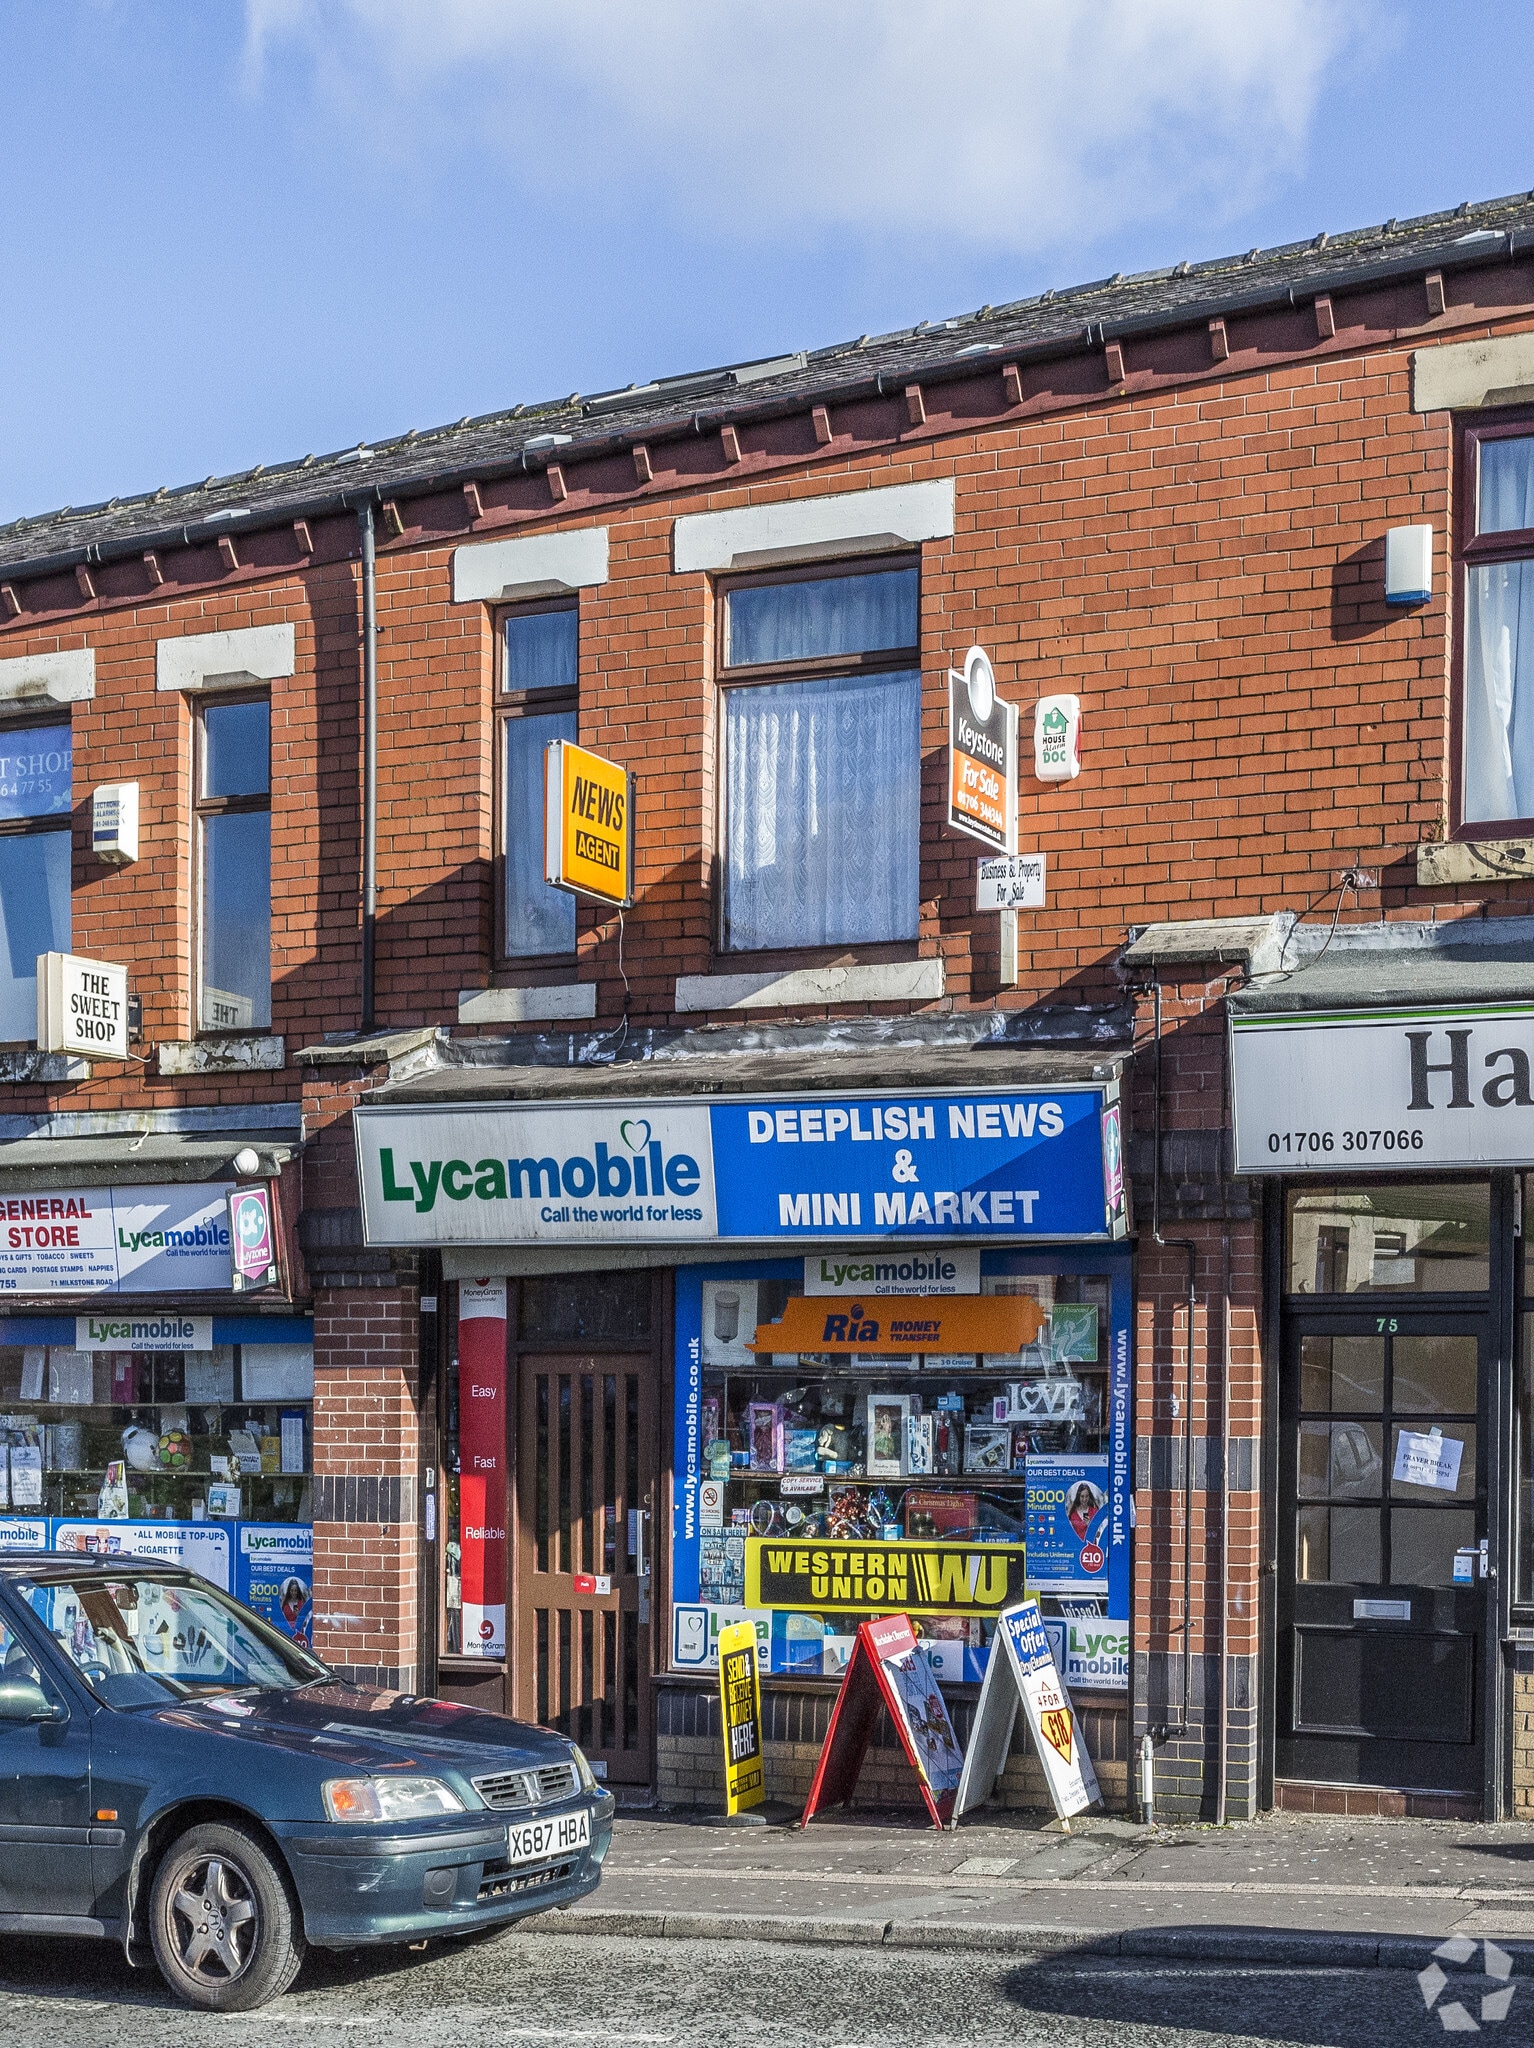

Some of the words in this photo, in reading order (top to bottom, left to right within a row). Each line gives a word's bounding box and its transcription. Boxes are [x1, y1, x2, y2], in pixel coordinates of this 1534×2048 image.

[958, 717, 1004, 765] Keystone
[1043, 735, 1066, 744] HOUSE
[16, 751, 72, 777] SHOP
[1043, 750, 1066, 764] DOC
[963, 760, 979, 788] For
[979, 768, 999, 801] Sale
[571, 776, 625, 831] NEWS
[577, 833, 620, 868] AGENT
[981, 860, 1007, 880] Business
[1008, 864, 1016, 878] &
[1018, 860, 1041, 883] Property
[997, 883, 1007, 902] For
[1011, 881, 1024, 901] Sale
[81, 972, 110, 997] THE
[71, 994, 120, 1021] SWEET
[76, 1017, 116, 1042] SHOP
[1404, 1028, 1534, 1111] Ha
[748, 1105, 935, 1143] DEEPLISH
[949, 1102, 1064, 1138] NEWS
[1268, 1131, 1335, 1153] 01706
[1342, 1129, 1424, 1151] 307066
[379, 1140, 701, 1213] Lycamobile
[892, 1149, 920, 1183] &
[541, 1206, 570, 1222] Call
[573, 1206, 598, 1222] the
[600, 1205, 643, 1221] world
[646, 1205, 669, 1221] for
[671, 1204, 703, 1221] less
[779, 1192, 861, 1226] MINI
[874, 1190, 1039, 1225] MARKET
[8, 1225, 80, 1248] STORE
[118, 1224, 229, 1252] Lycamobile
[166, 1249, 178, 1257] Call
[178, 1249, 189, 1257] the
[190, 1249, 208, 1257] world
[209, 1248, 218, 1256] for
[89, 1264, 114, 1272] NAPPIES
[821, 1256, 956, 1286] Lycamobile
[463, 1288, 503, 1297] MoneyGram
[875, 1286, 890, 1294] Call
[891, 1285, 904, 1293] the
[904, 1285, 927, 1293] world
[928, 1285, 939, 1293] for
[940, 1285, 956, 1293] less
[89, 1318, 194, 1342] Lycamobile
[822, 1304, 880, 1342] Ria
[890, 1321, 942, 1332] MONEY
[1376, 1318, 1398, 1332] 75
[889, 1334, 940, 1342] TRANSFER
[471, 1385, 497, 1400] Easy
[684, 1337, 700, 1540] www.lycamobile.co.uk
[1112, 1328, 1129, 1546] www.lycamobile.co.uk
[474, 1456, 496, 1469] Fast
[1062, 1469, 1085, 1477] DEALS
[1403, 1454, 1429, 1465] PRAYER
[1430, 1460, 1453, 1470] BREAK
[946, 1500, 964, 1508] Lights
[1026, 1490, 1065, 1503] 3000
[1027, 1503, 1056, 1511] Minutes
[138, 1531, 153, 1539] ALL
[155, 1531, 187, 1539] MOBILE
[189, 1532, 225, 1540] TOP-UPS
[247, 1534, 312, 1549] Lycamobil
[465, 1526, 506, 1540] Reliable
[138, 1545, 184, 1554] CIGARETTE
[1082, 1553, 1101, 1563] £10
[262, 1565, 277, 1573] BEST
[768, 1551, 908, 1576] WESTERN
[923, 1554, 1008, 1604] WU
[249, 1584, 279, 1596] 3000
[811, 1576, 907, 1600] UNION
[1008, 1608, 1041, 1638] Special
[467, 1641, 505, 1650] MoneyGram
[1021, 1631, 1045, 1655] Offer
[727, 1655, 745, 1682] SEND
[745, 1653, 751, 1677] &
[729, 1677, 752, 1705] RECEIVE
[1037, 1695, 1042, 1706] 4
[1043, 1693, 1060, 1706] FOR
[730, 1699, 753, 1727] MONEY
[731, 1721, 755, 1760] HERE
[512, 1823, 553, 1858] X687
[559, 1816, 588, 1848] HBA
